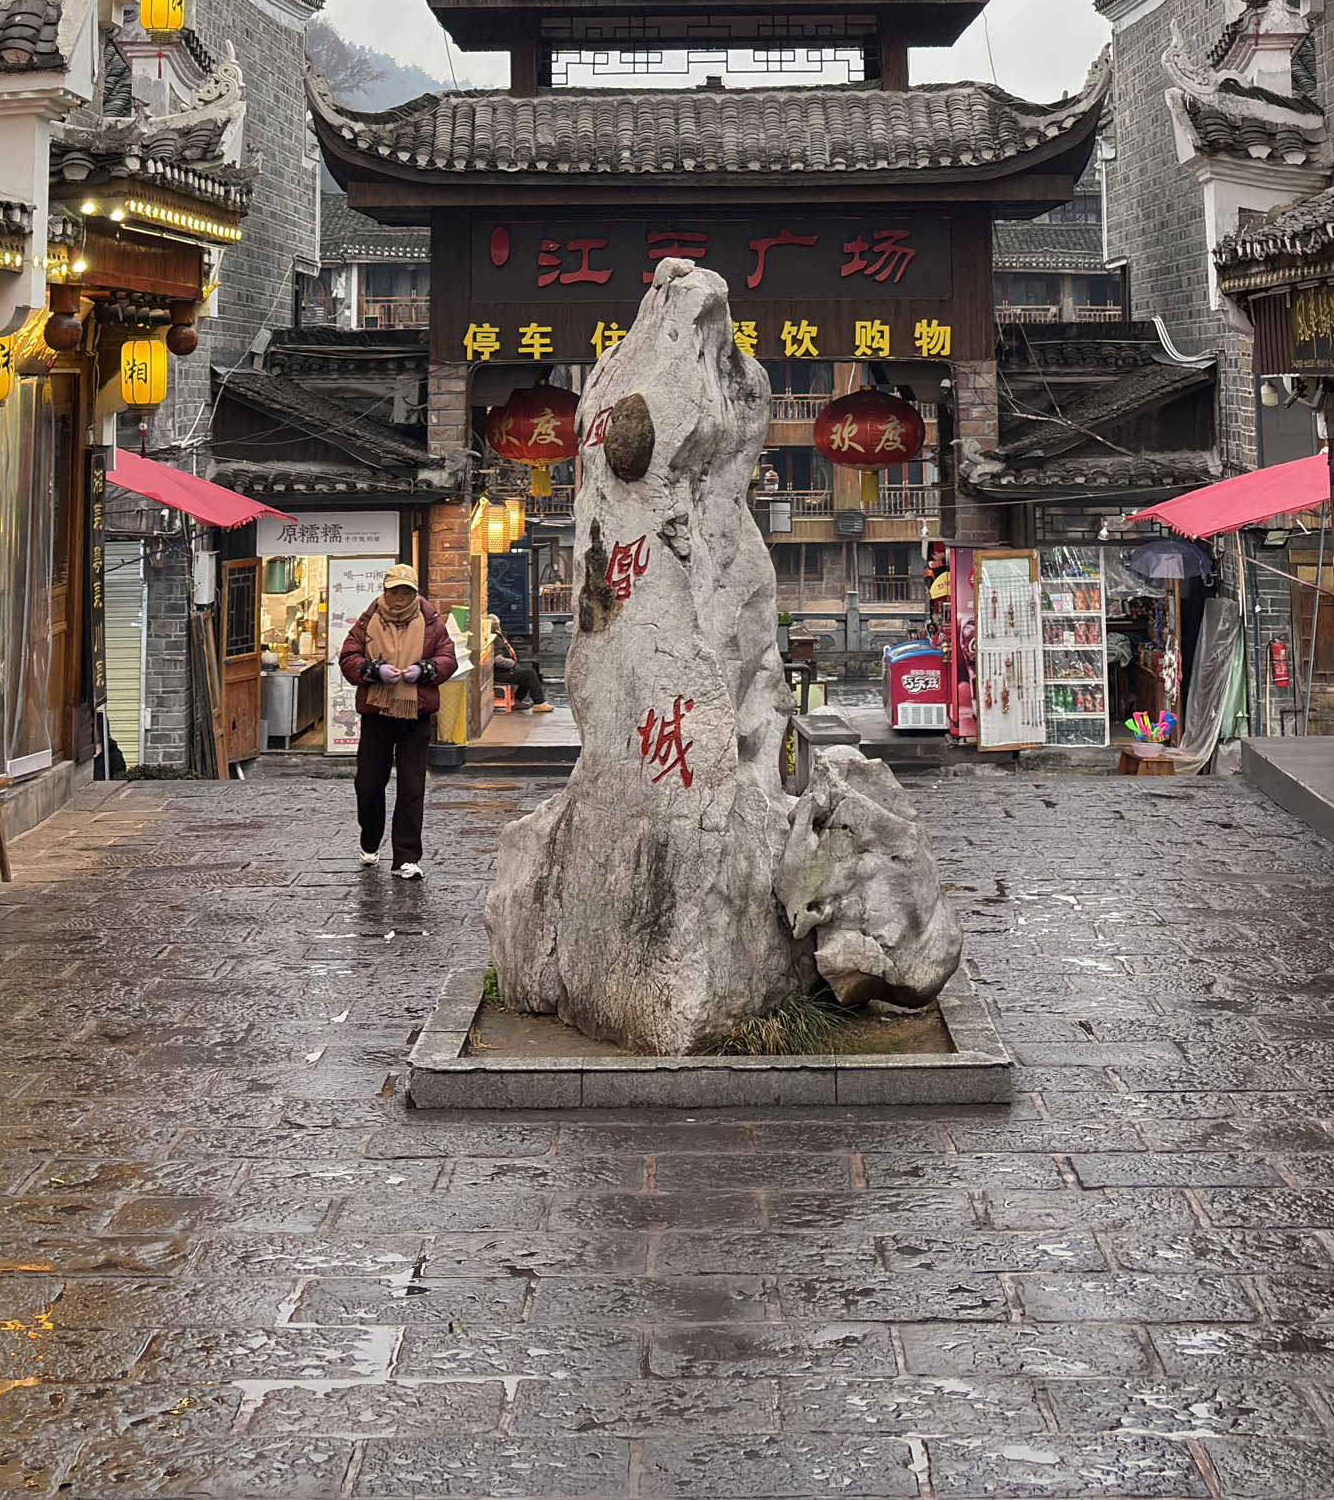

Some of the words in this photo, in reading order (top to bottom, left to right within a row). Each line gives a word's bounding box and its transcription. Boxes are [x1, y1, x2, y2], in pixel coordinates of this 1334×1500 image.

[124, 357, 148, 386] 湘
[491, 408, 563, 448] 欢度
[830, 412, 907, 454] 欢度
[276, 523, 343, 544] 原糯糯
[343, 570, 387, 581] 喝一口湘
